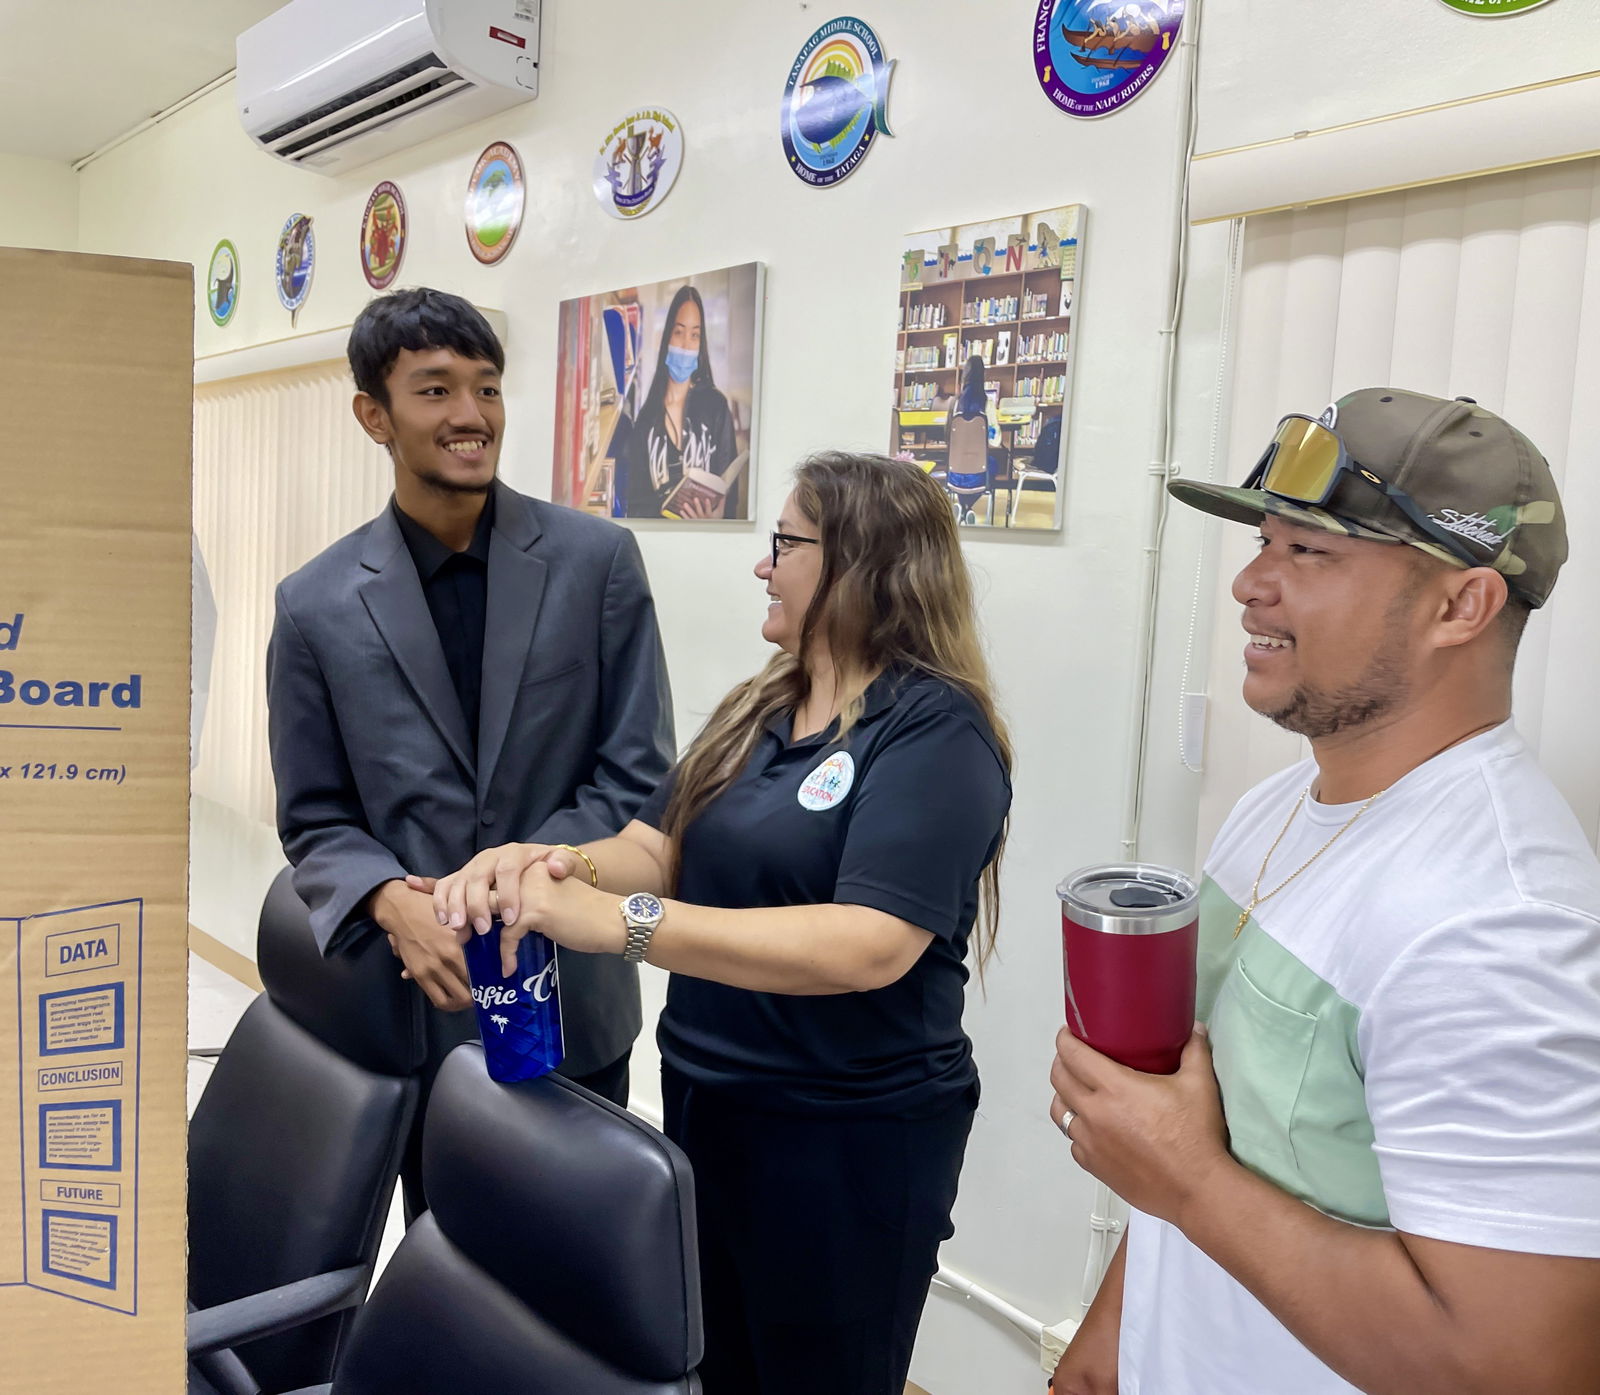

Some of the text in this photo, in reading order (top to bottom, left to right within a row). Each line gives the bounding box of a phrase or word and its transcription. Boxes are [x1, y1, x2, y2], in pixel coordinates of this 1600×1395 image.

[788, 19, 878, 87] TANAPAG MIDDLE SCHOOL
[1052, 88, 1077, 110] HOME
[1095, 93, 1122, 111] NAPU
[1121, 63, 1155, 99] RIDERS
[795, 161, 818, 184] HOME
[834, 145, 866, 178] TATAGA
[20, 762, 79, 781] 121.9
[85, 764, 127, 785] cm)
[58, 938, 109, 965] DATA
[40, 1066, 121, 1087] CONCLUSION
[56, 1186, 104, 1201] FUTURE
